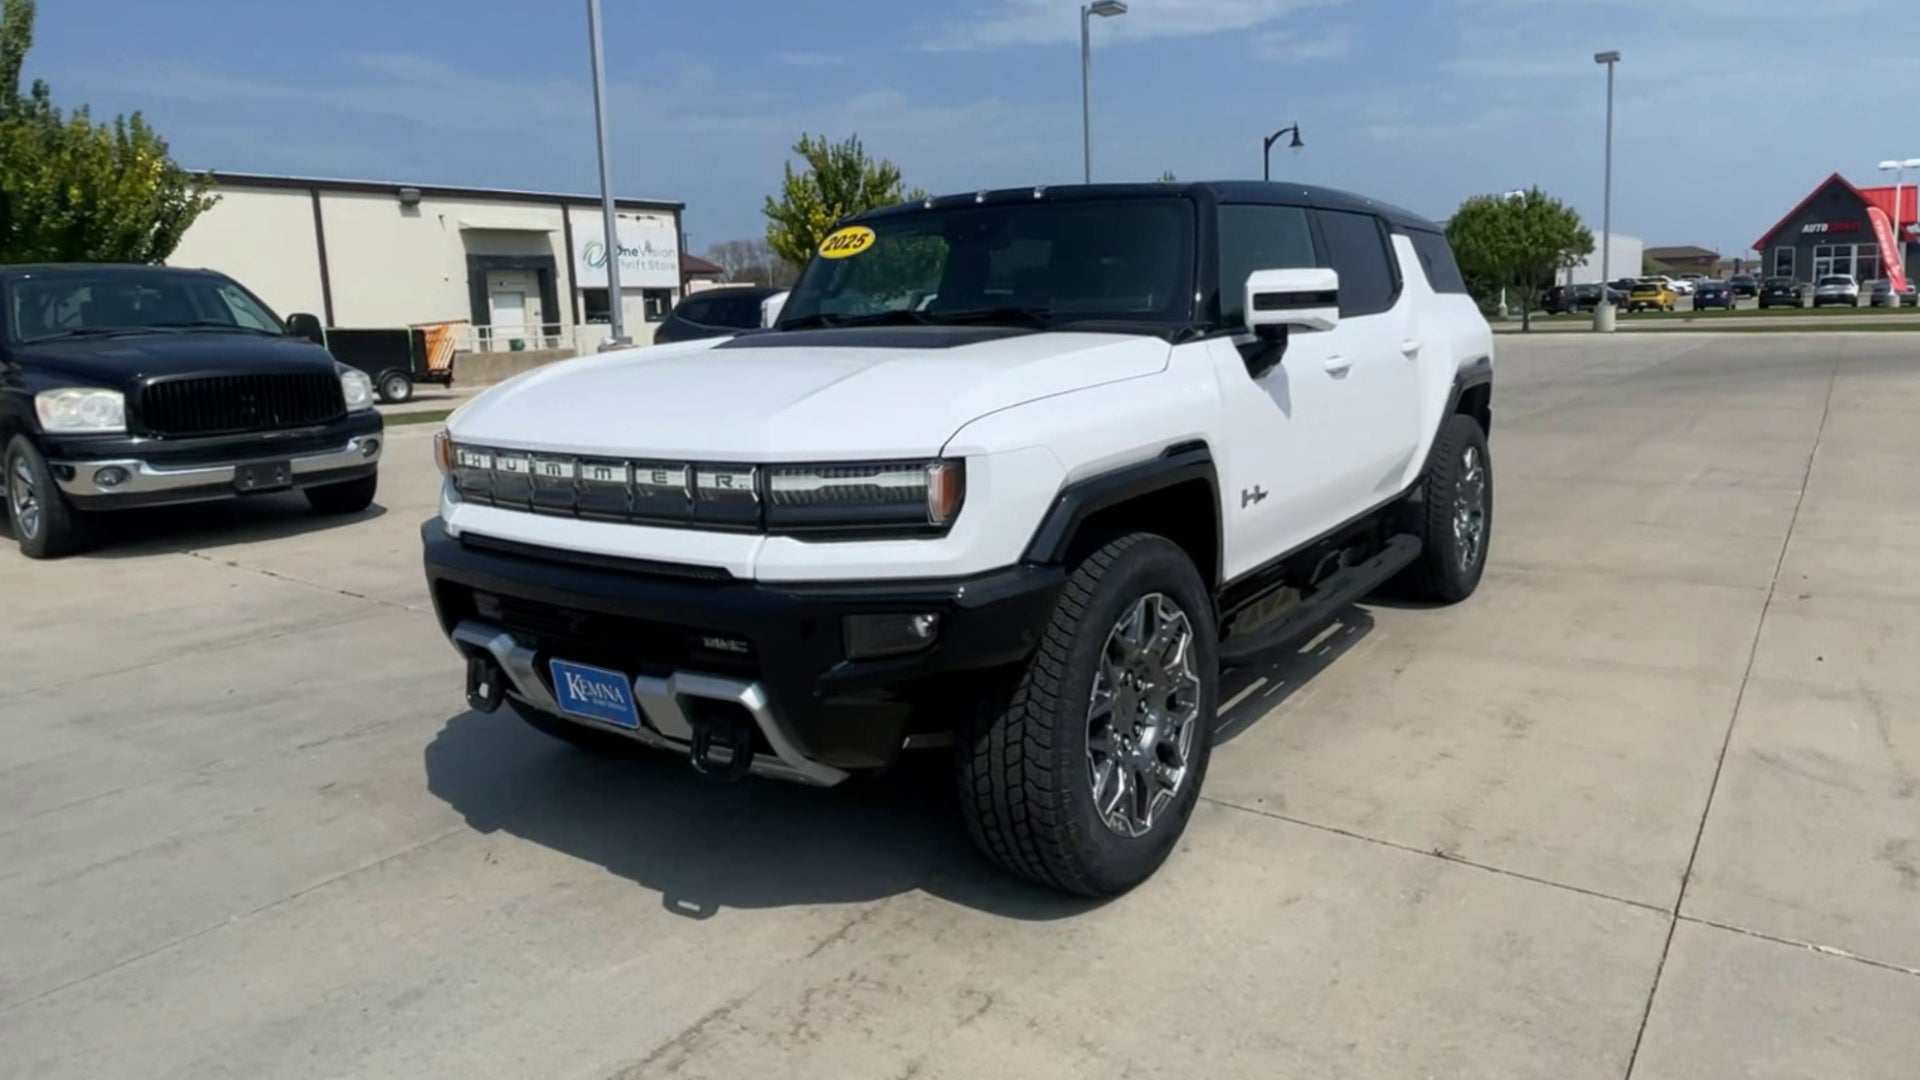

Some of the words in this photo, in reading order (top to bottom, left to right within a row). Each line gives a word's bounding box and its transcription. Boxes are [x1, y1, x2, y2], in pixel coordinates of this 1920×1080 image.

[823, 232, 870, 251] 2025
[472, 453, 733, 488] HUMMER
[564, 672, 625, 704] KEMNA
